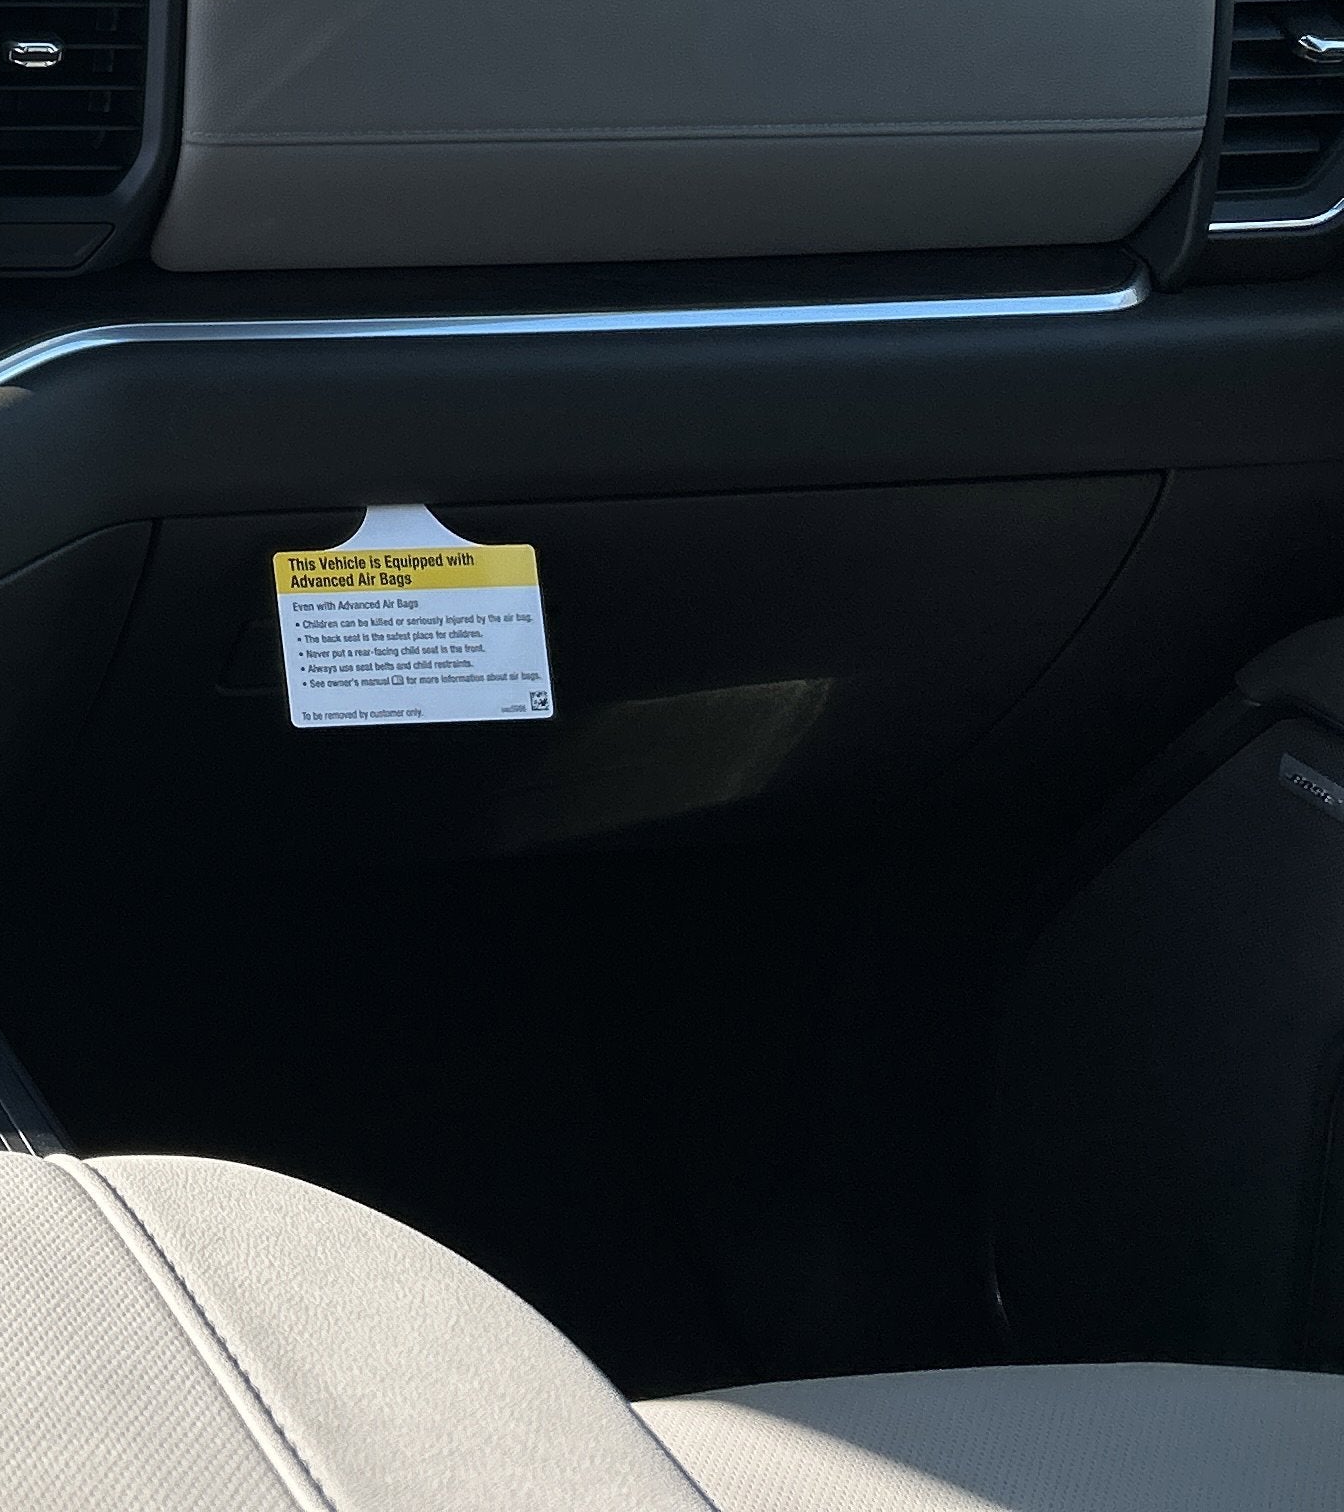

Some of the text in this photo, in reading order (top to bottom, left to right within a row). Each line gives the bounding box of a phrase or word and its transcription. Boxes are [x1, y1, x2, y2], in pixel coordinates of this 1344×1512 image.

[288, 552, 475, 572] This Vehicle is Equipped with
[290, 571, 413, 589] Advanced Air Bags
[292, 598, 419, 612] Even with Advanced Air Bags
[302, 707, 424, 721] To be removed by customer only.
